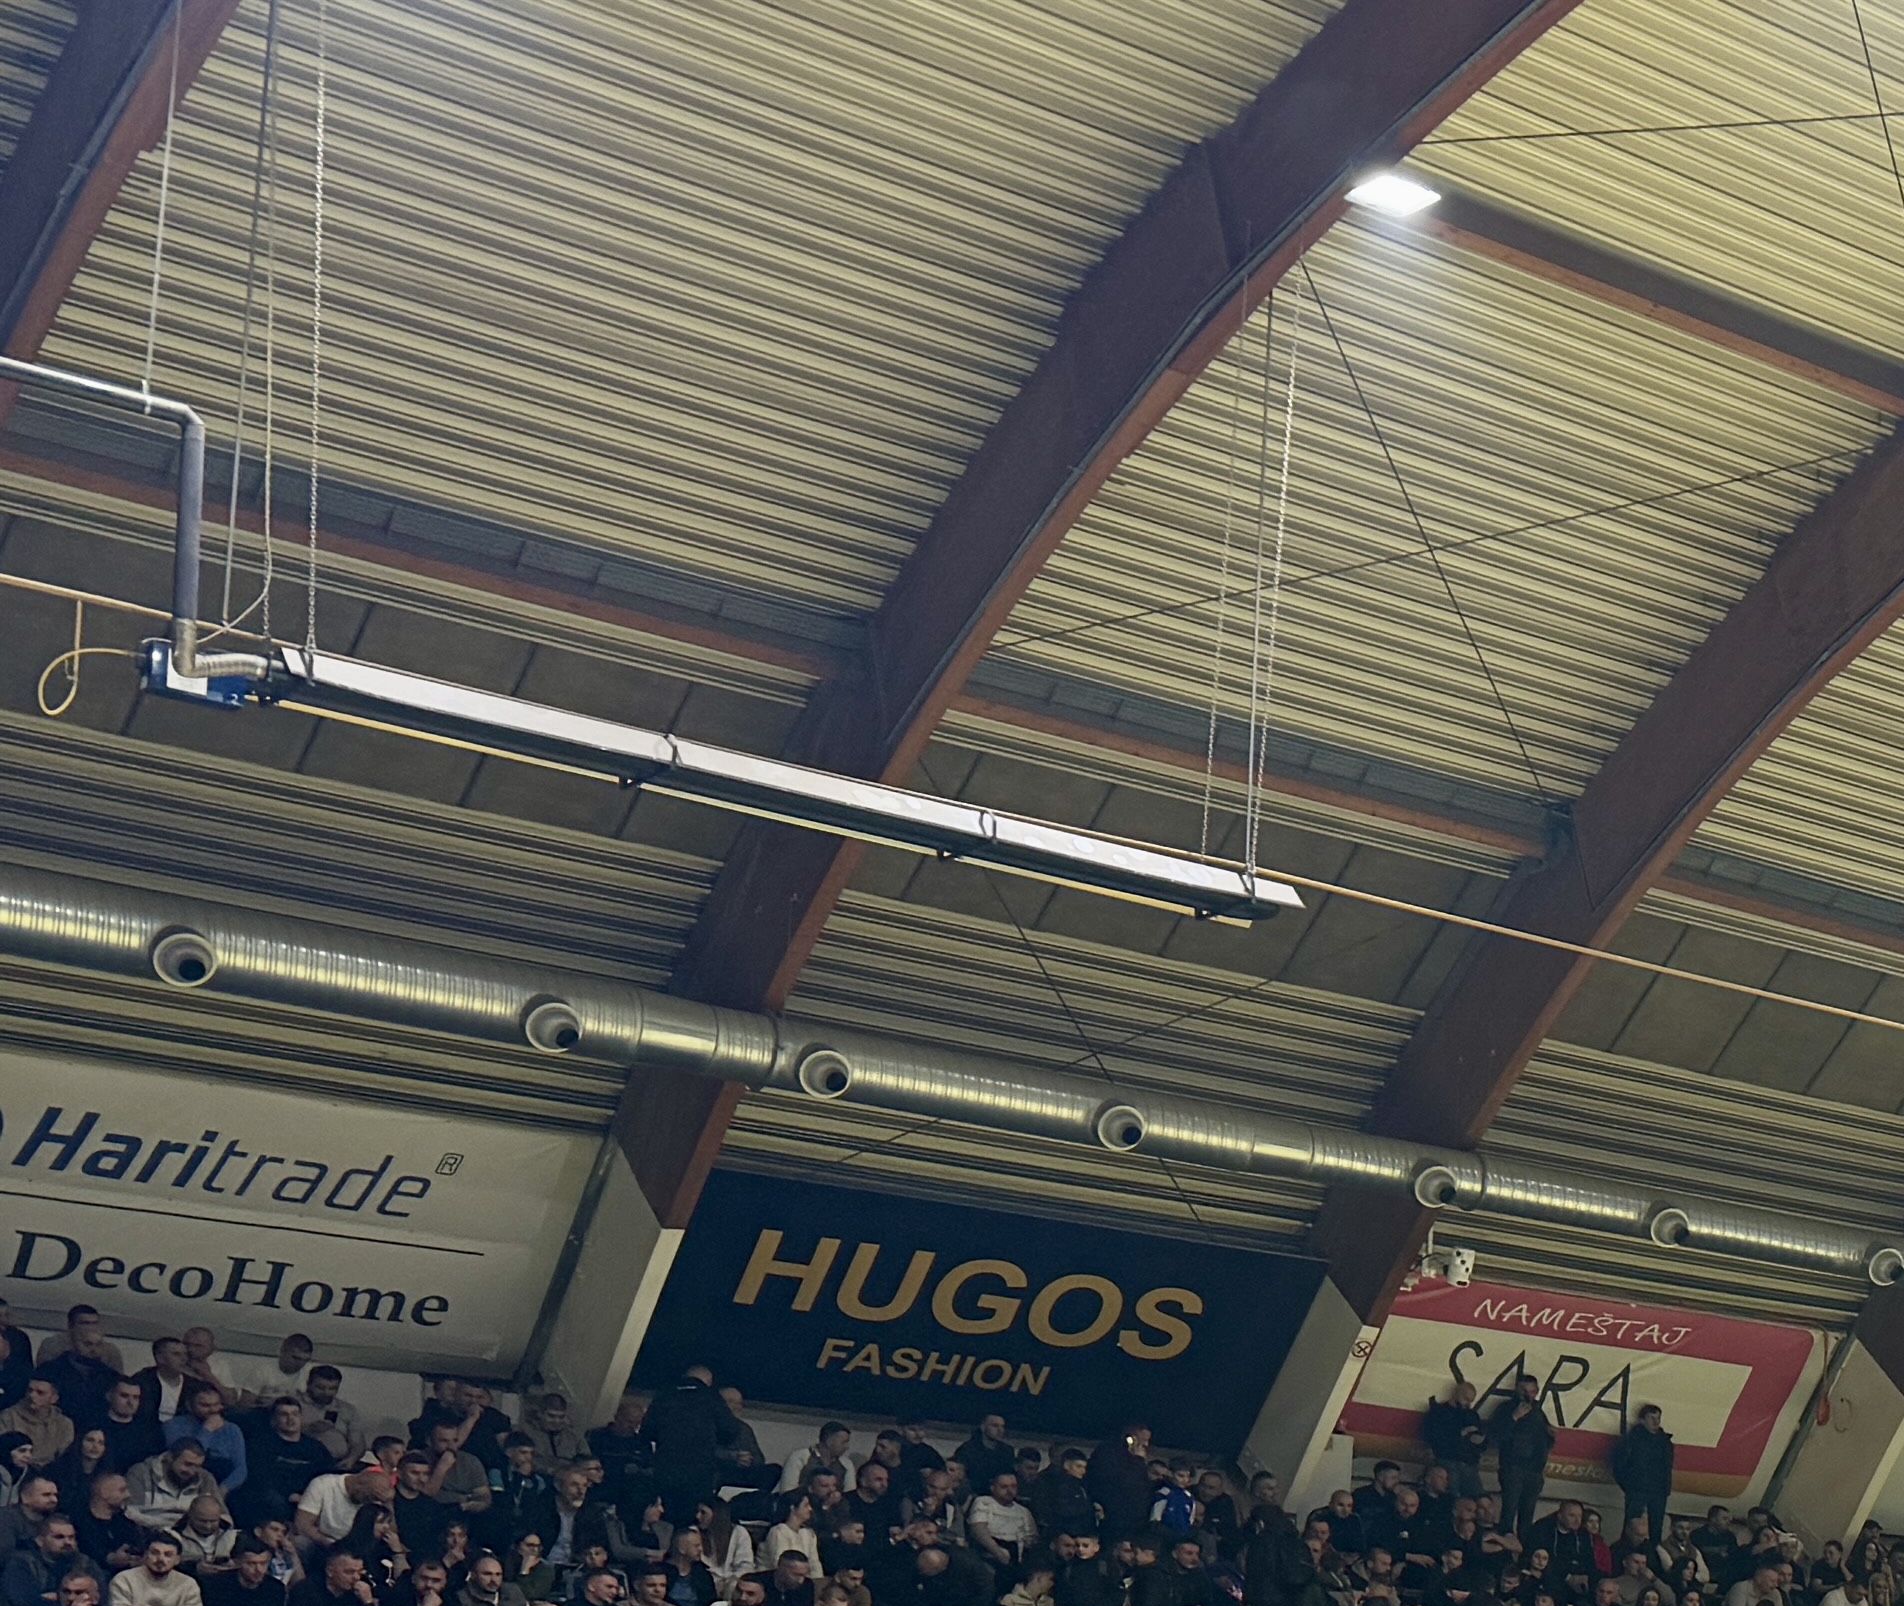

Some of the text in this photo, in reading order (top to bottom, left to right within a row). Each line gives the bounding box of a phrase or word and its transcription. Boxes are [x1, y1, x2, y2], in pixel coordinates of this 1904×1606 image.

[6, 1230, 450, 1327] DecoHome
[732, 1229, 1203, 1360] HUGOS
[1474, 1298, 1691, 1346] NAMEŠTAJ
[816, 1339, 1050, 1395] FASHION
[1429, 1340, 1630, 1436] SARA
